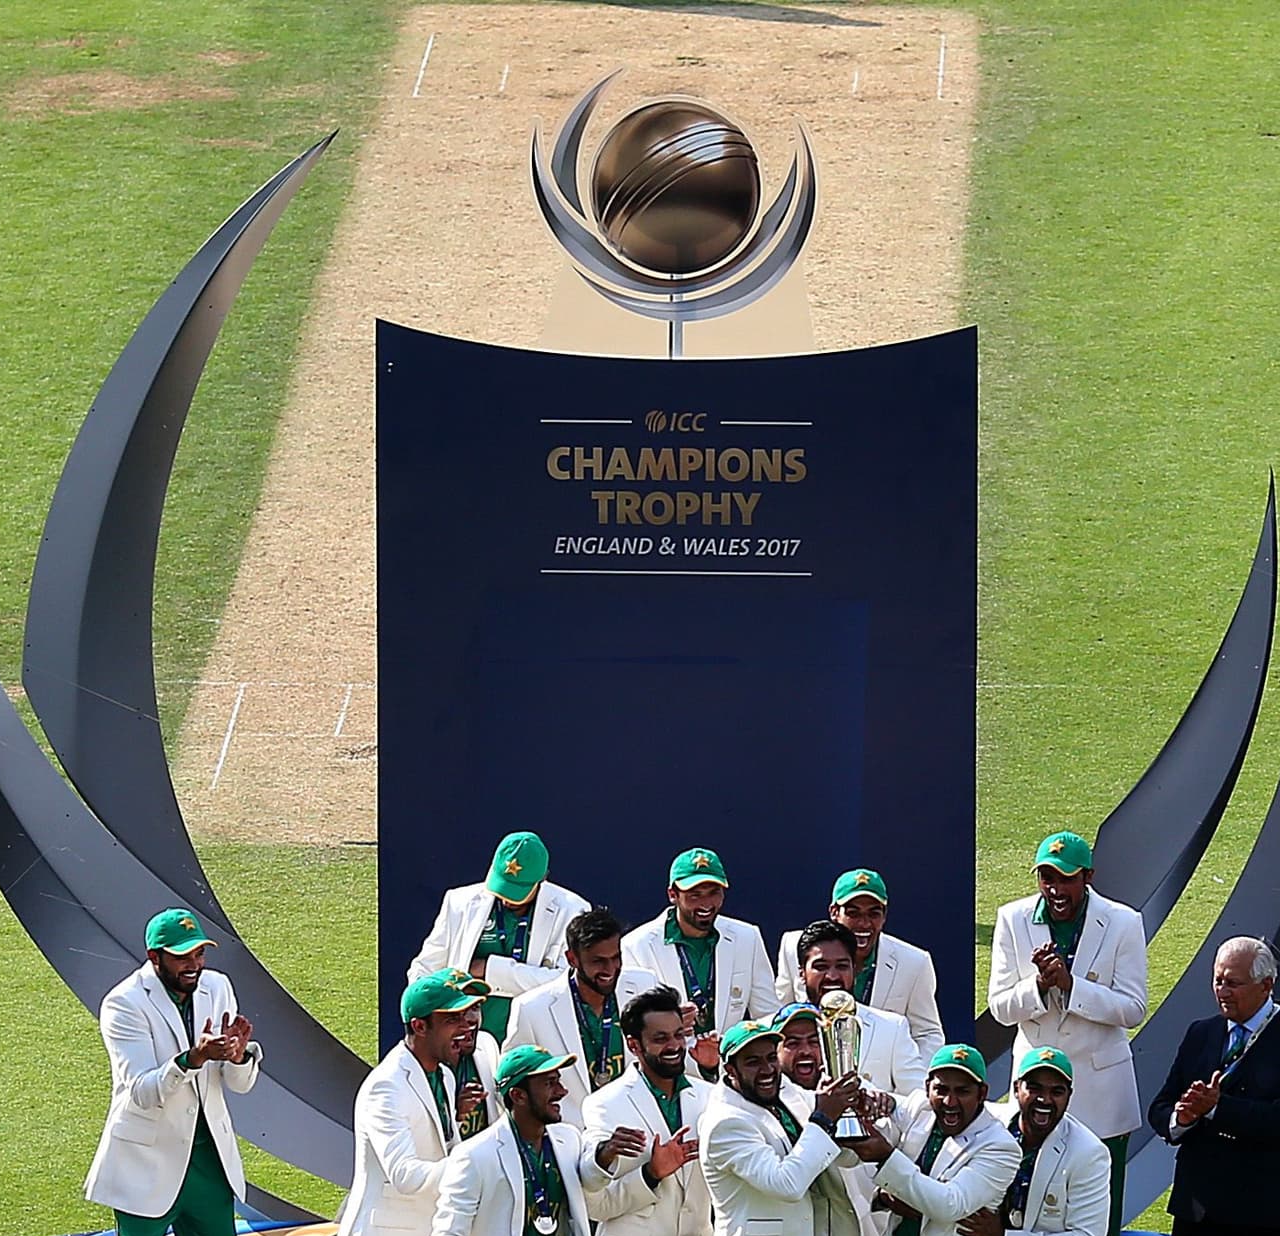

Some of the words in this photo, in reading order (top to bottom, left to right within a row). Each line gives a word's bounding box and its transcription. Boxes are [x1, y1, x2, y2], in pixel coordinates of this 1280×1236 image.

[669, 412, 708, 432] ICC
[546, 446, 808, 483] CHAMPIONS
[591, 490, 762, 526] TROPHY
[554, 536, 654, 555] ENGLAND
[658, 536, 676, 556] &
[683, 538, 751, 556] WALES
[754, 539, 802, 557] 2017
